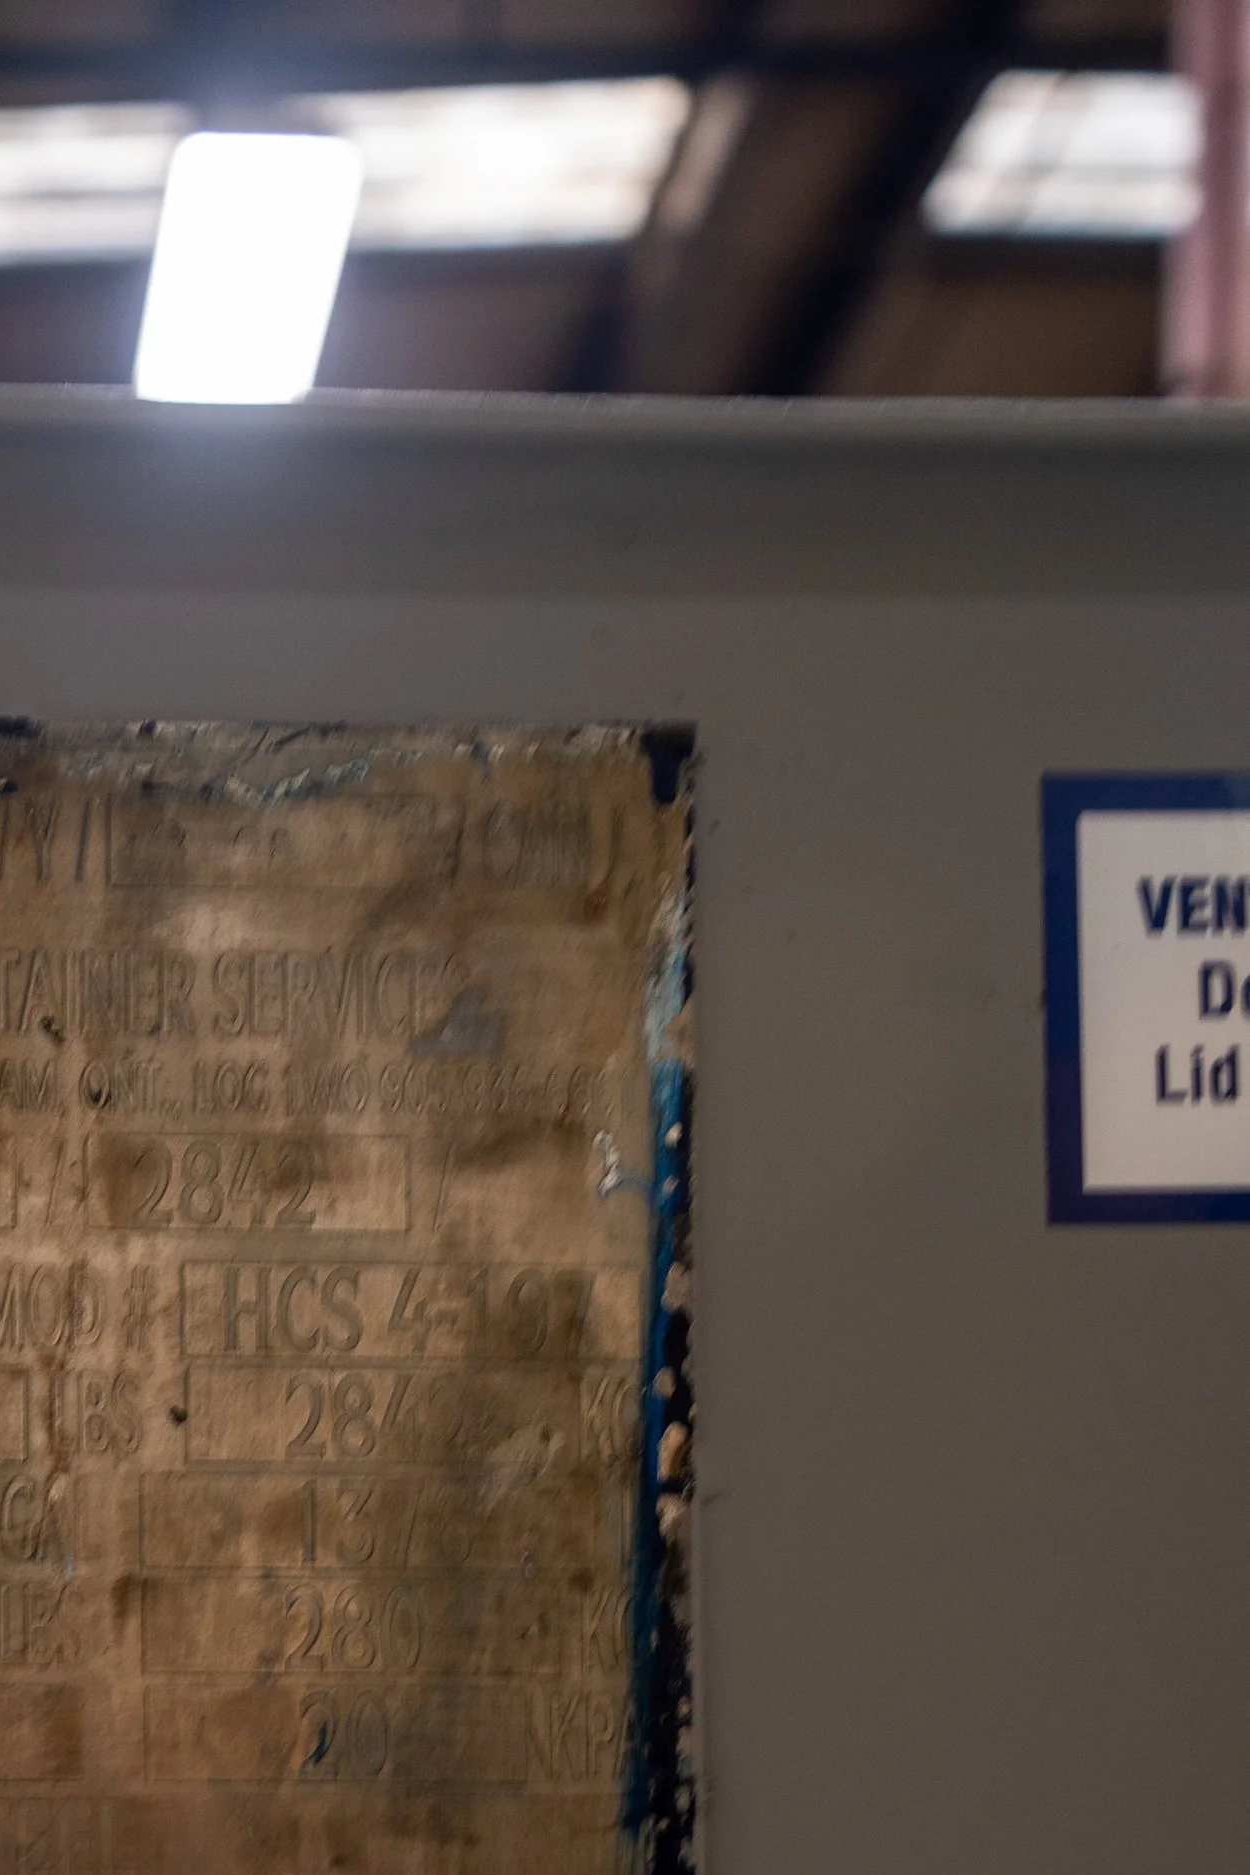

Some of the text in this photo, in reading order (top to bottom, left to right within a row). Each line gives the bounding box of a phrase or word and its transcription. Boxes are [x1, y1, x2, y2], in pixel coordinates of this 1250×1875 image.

[1136, 873, 1250, 935] VEN
[1199, 959, 1250, 1020] D
[1154, 1044, 1239, 1106] Lid
[221, 1265, 363, 1354] HCS
[50, 1368, 142, 1453] LBS
[284, 1583, 422, 1671] 280
